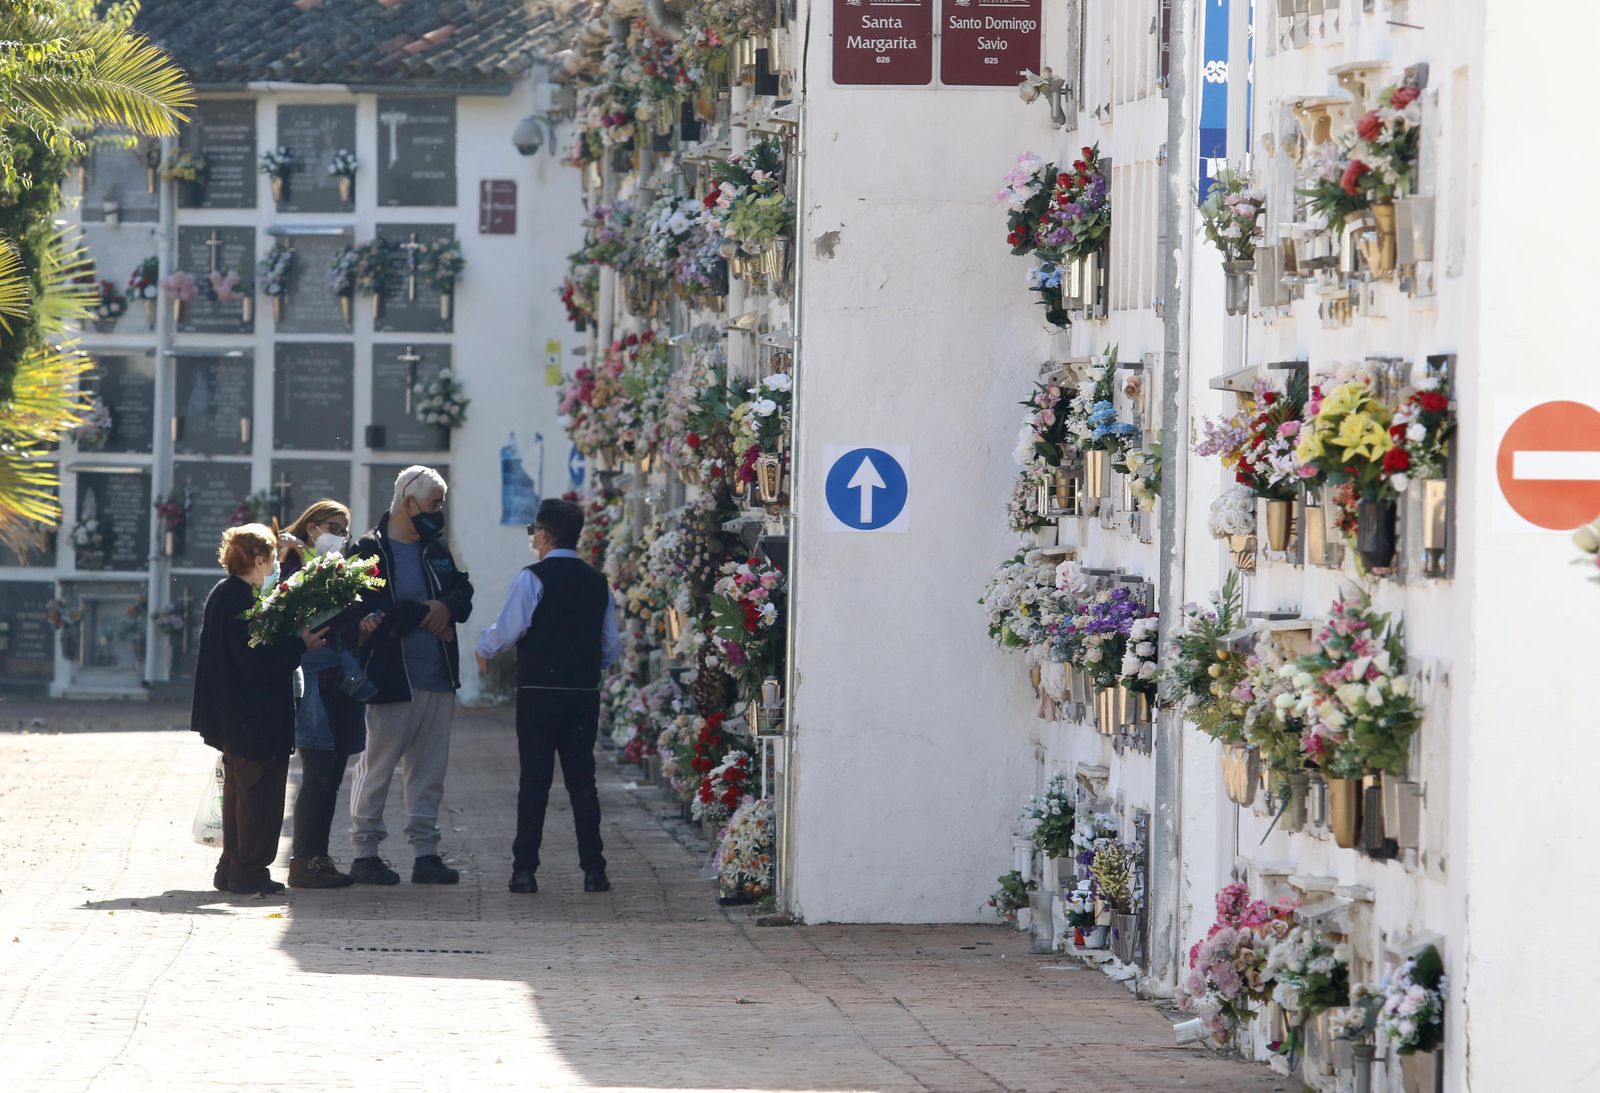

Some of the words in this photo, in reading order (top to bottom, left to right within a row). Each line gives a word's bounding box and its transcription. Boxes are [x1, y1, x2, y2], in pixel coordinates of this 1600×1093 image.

[861, 14, 903, 29] Santa
[949, 15, 982, 29] Santo
[985, 16, 1037, 34] Domingo
[846, 35, 918, 53] Margarita
[977, 36, 1008, 50] Savio
[876, 56, 891, 64] 626
[984, 57, 999, 65] 625
